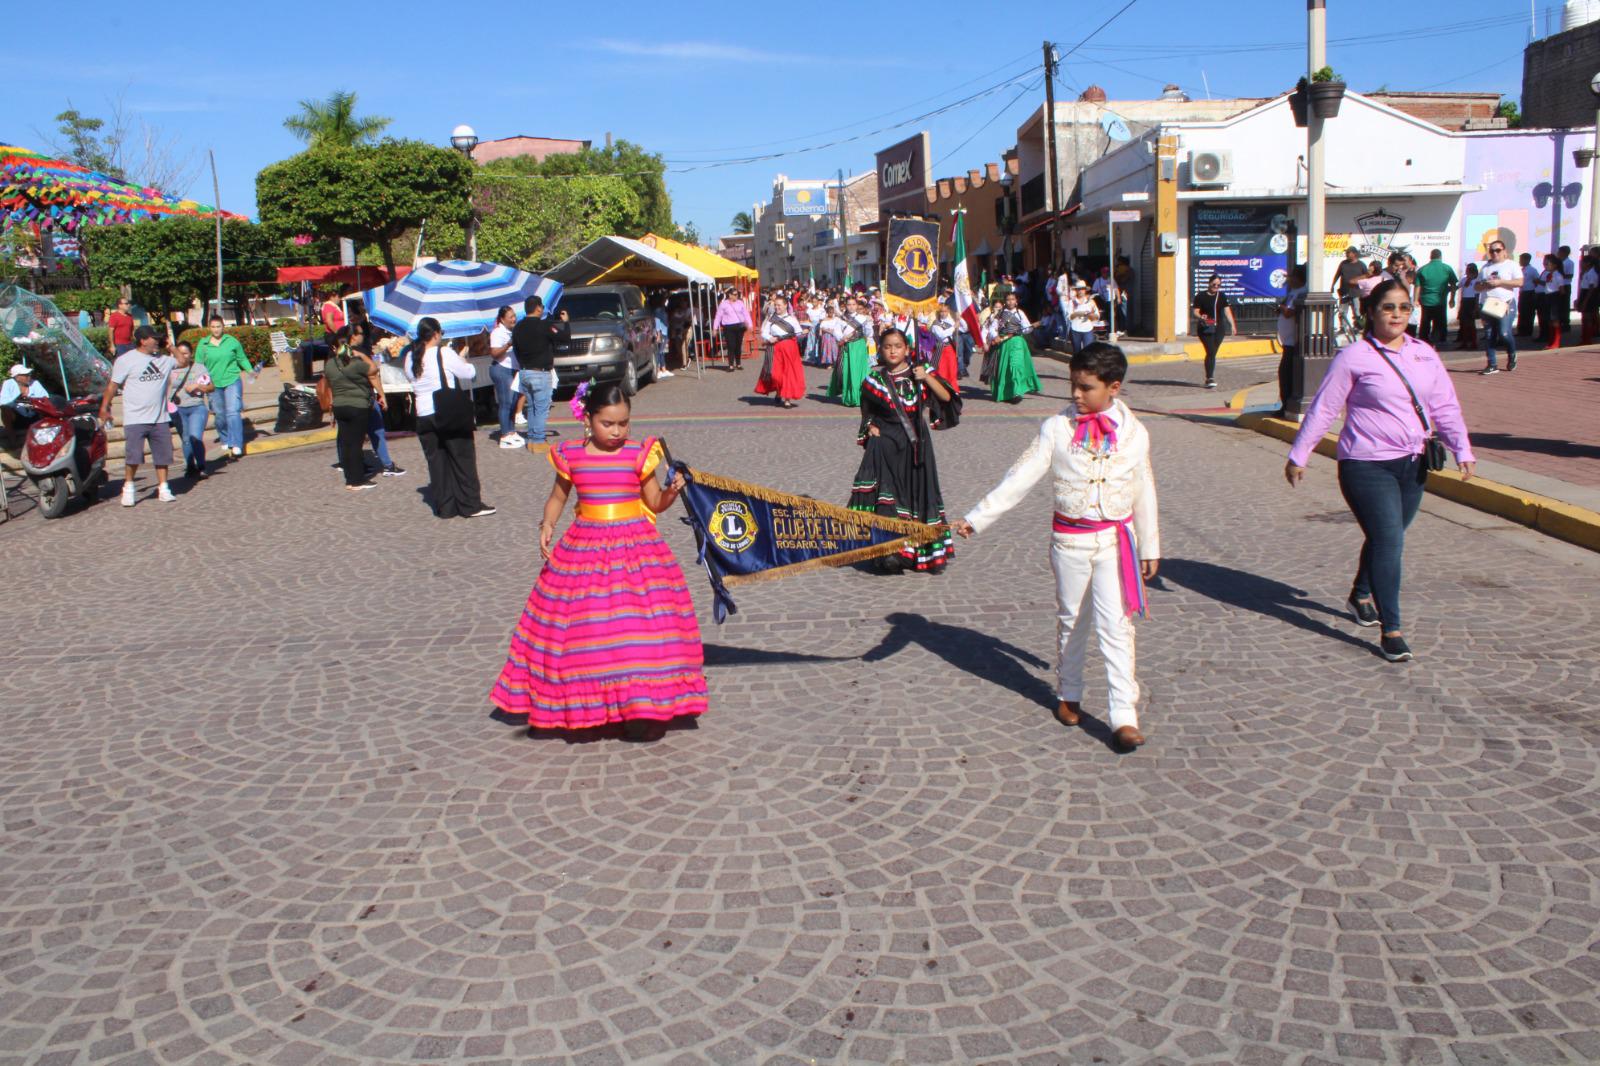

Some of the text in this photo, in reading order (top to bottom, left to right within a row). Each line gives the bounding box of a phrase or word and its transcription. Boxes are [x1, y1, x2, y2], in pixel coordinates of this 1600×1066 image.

[883, 150, 912, 188] Comex
[912, 251, 925, 271] L
[726, 515, 742, 535] L
[774, 518, 871, 540] CLUB DE LEONES
[821, 541, 838, 550] SIN.
